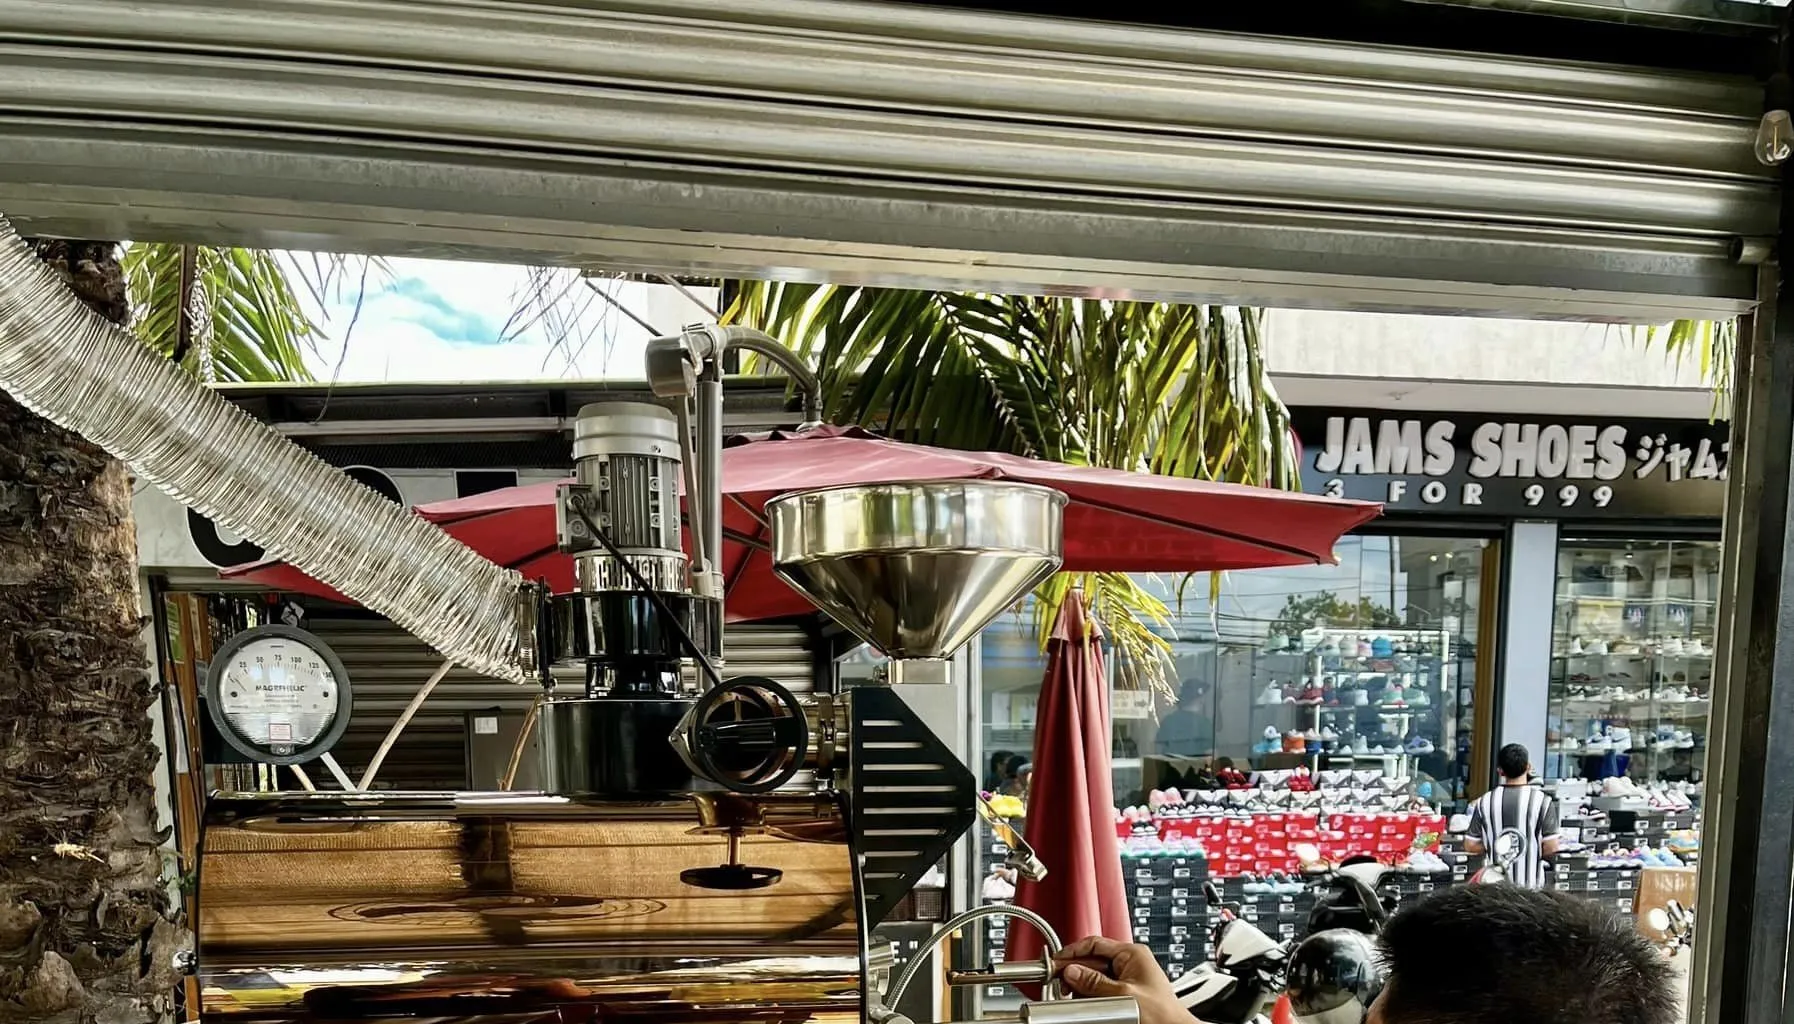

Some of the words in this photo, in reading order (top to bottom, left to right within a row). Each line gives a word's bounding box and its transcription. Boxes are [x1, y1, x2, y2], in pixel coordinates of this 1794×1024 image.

[1315, 416, 1456, 476] JAMS
[1468, 421, 1628, 481] SHOES
[1326, 478, 1345, 499] 3
[1388, 480, 1484, 505] FOR
[1525, 484, 1614, 508] 999
